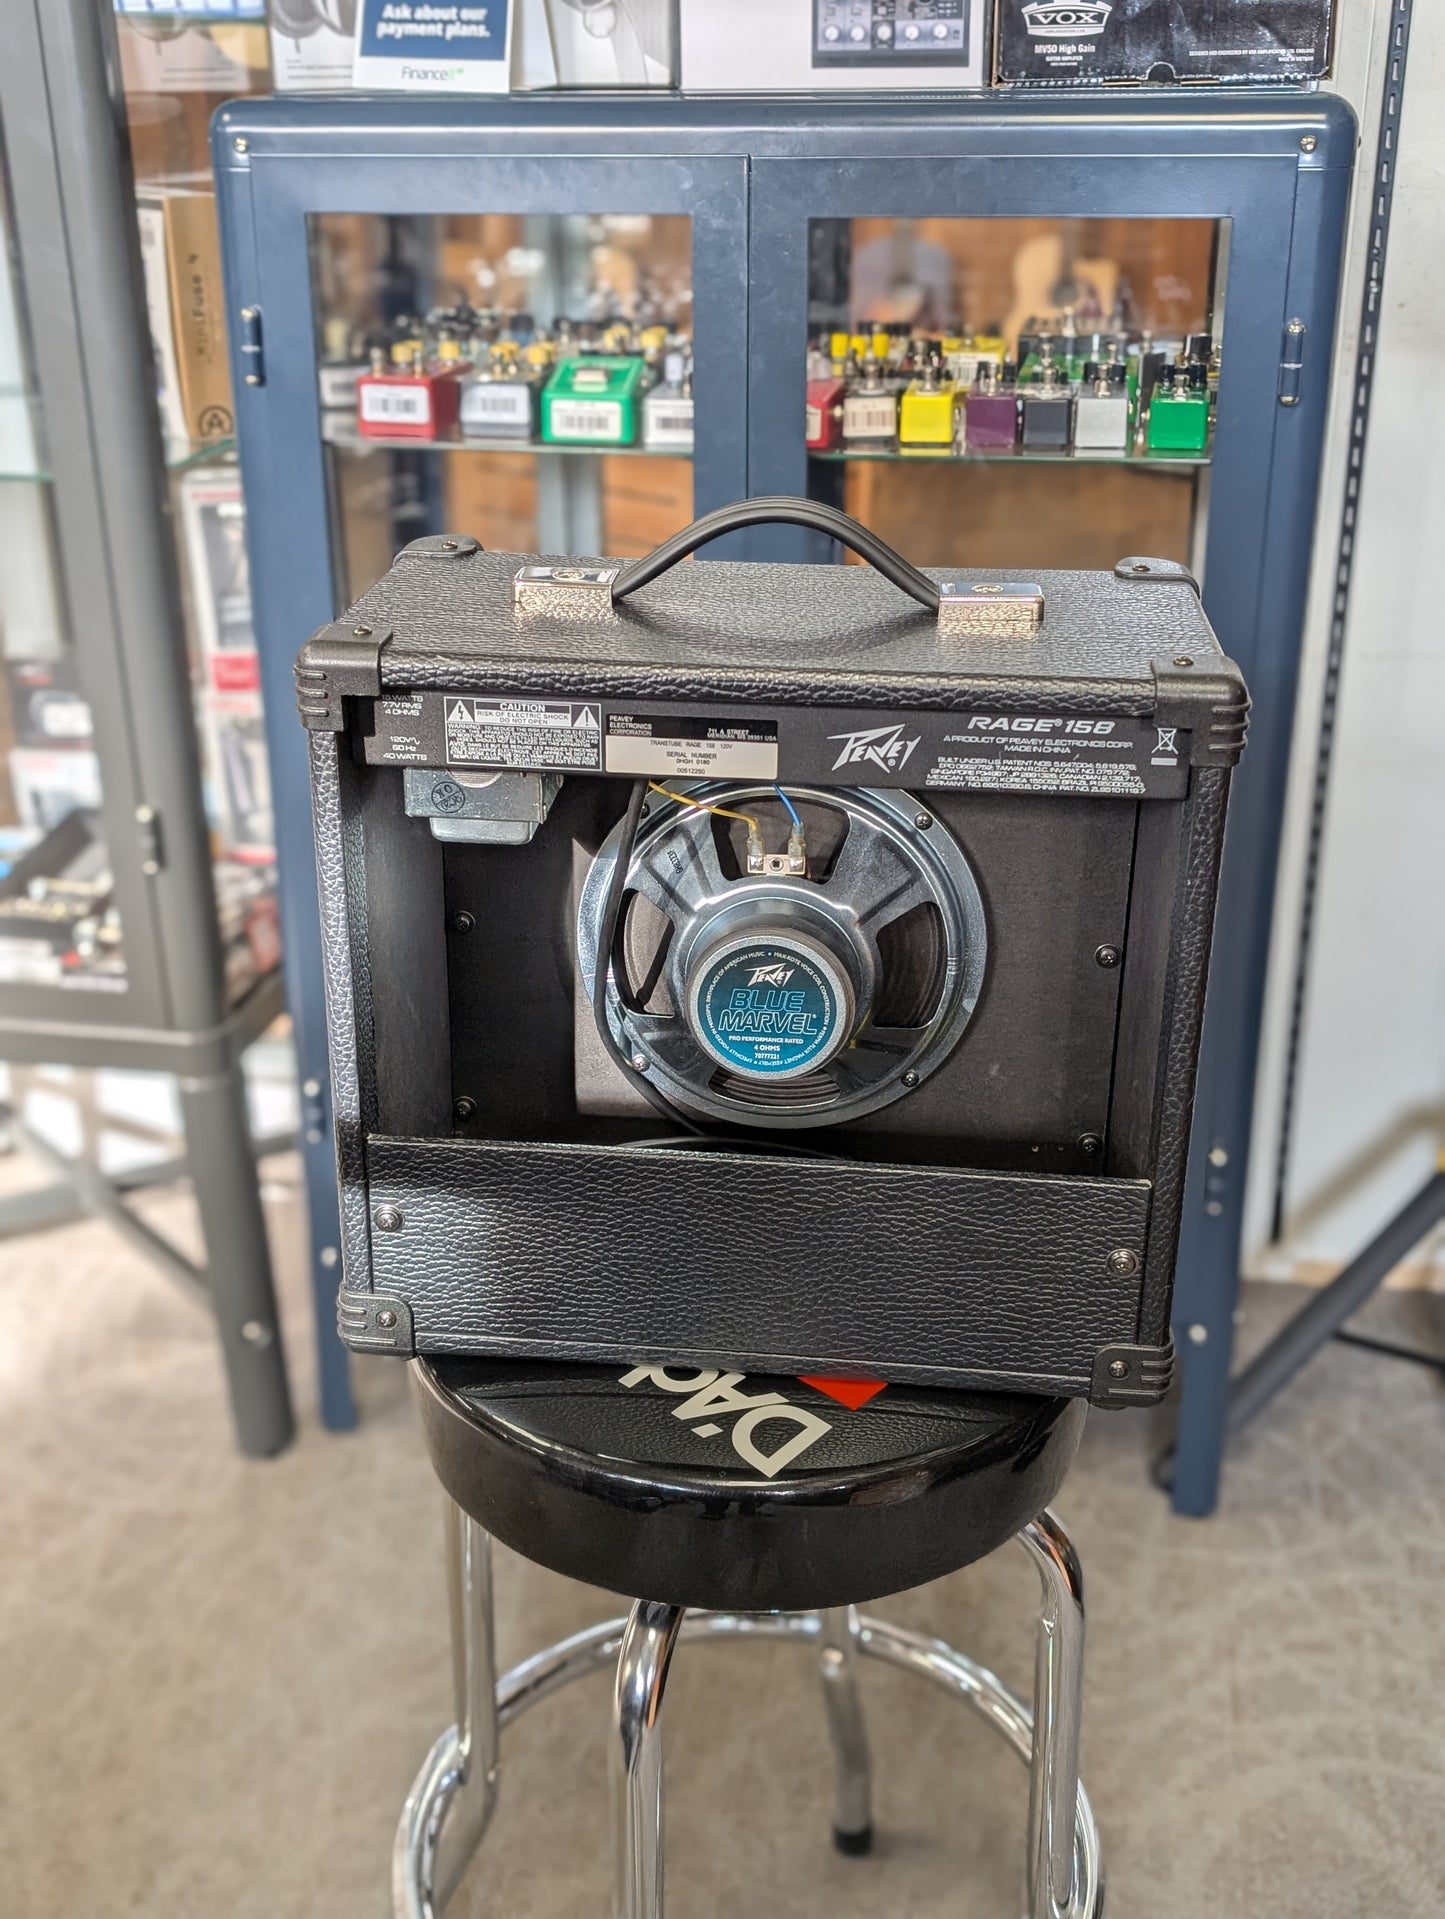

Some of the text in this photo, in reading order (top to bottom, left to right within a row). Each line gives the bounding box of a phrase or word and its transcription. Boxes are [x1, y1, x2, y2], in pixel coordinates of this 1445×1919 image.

[382, 4, 488, 21] Ask about our
[1033, 12, 1098, 24] VOX
[376, 21, 491, 40] payment plans.
[1034, 44, 1096, 54] MV50 High Gain
[401, 66, 456, 80] Financeit
[500, 703, 545, 712] CAUTION
[967, 716, 1115, 734] RAGE 158
[1045, 739, 1105, 747] ELECTRONICS
[729, 988, 805, 1012] BLUE
[718, 1009, 818, 1034] MARVEL
